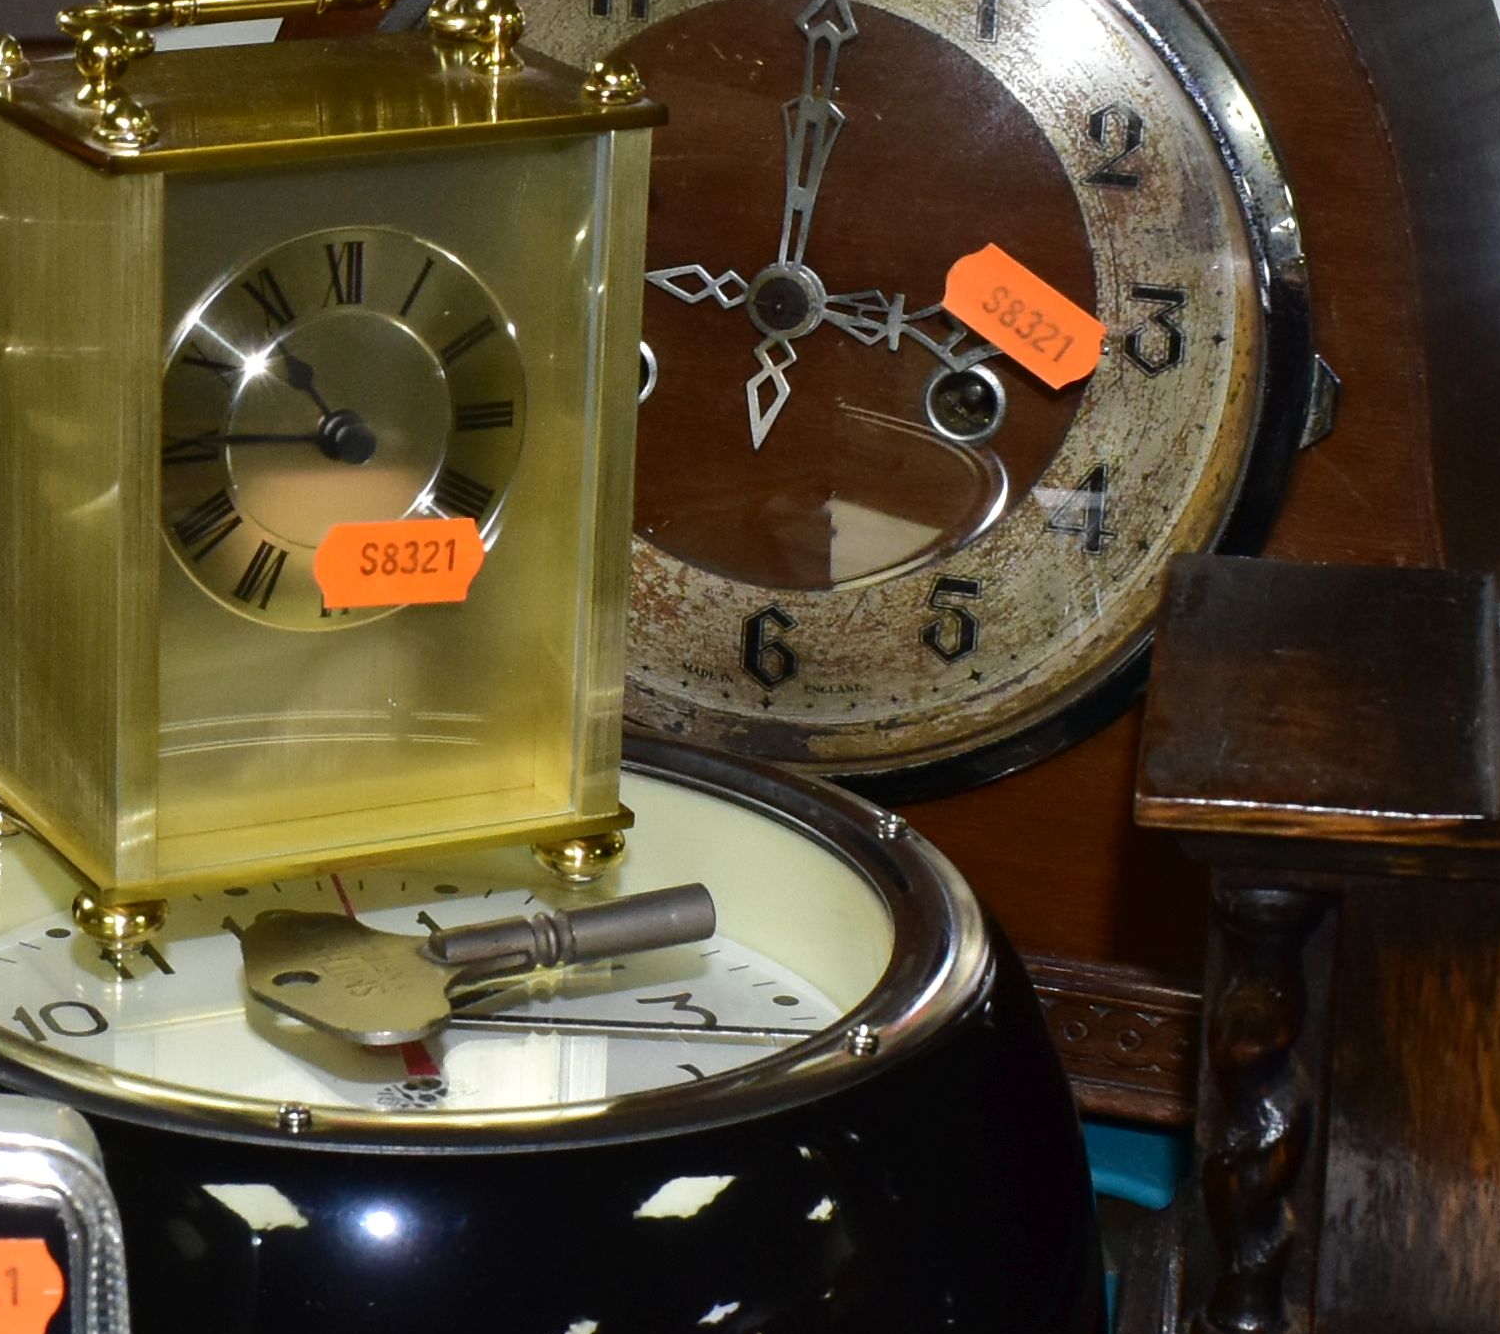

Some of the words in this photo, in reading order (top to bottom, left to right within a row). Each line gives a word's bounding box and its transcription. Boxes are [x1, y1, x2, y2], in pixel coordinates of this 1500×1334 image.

[1084, 103, 1143, 192] 2
[322, 240, 365, 308] XII
[398, 257, 435, 317] I
[439, 315, 498, 365] II
[980, 283, 1076, 369] S8321
[1124, 284, 1188, 380] 3
[456, 399, 514, 433] III
[1047, 463, 1117, 556] 4
[233, 539, 289, 611] VII
[359, 539, 457, 577] S8321
[738, 605, 800, 692] 6
[919, 578, 983, 667] 5
[12, 1000, 109, 1042] 10
